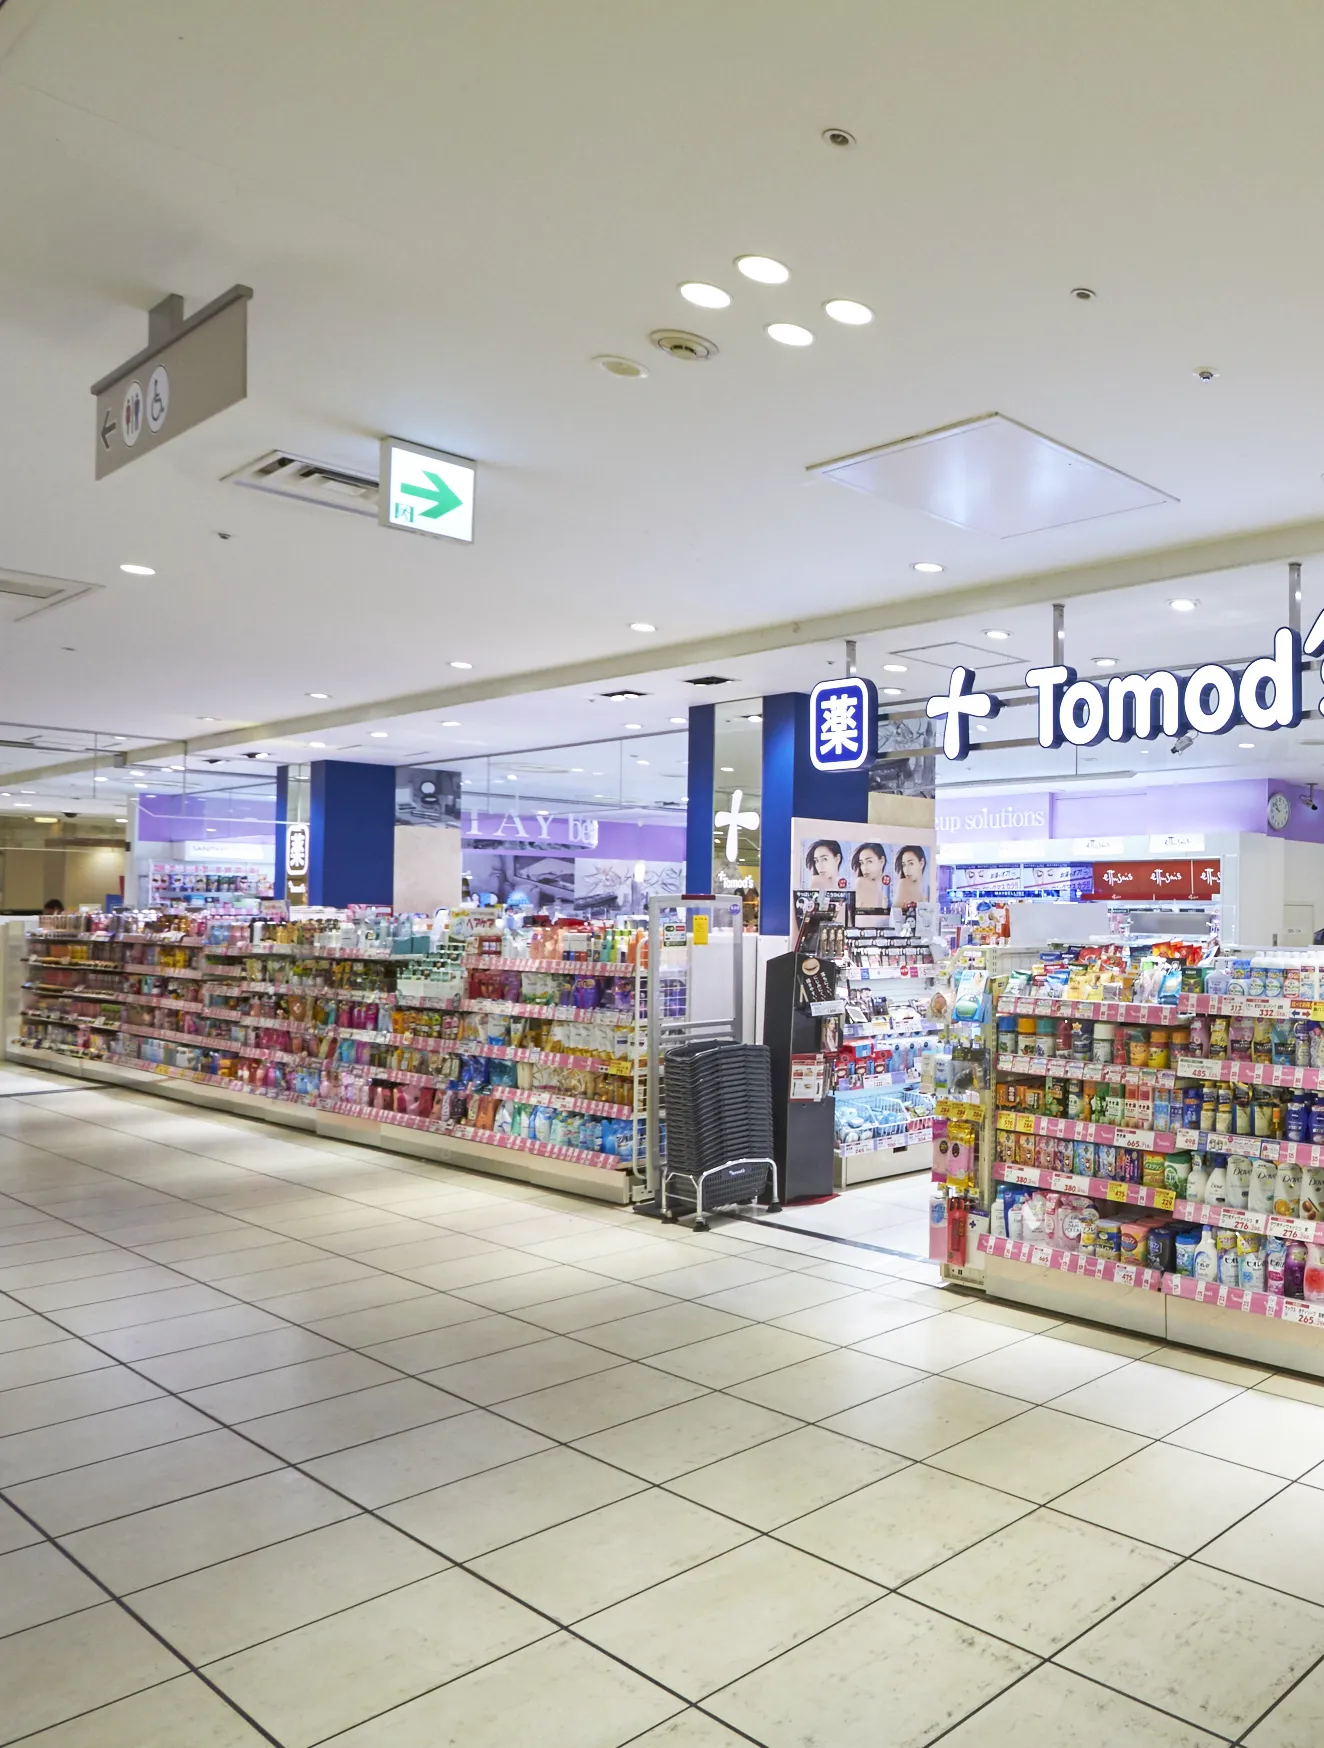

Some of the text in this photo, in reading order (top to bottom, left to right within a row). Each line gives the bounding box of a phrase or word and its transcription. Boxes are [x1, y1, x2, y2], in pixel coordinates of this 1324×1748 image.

[820, 694, 859, 755] 薬
[965, 806, 1046, 831] solutions
[1259, 1008, 1274, 1017] 332
[1192, 1070, 1206, 1078] 485
[1126, 1140, 1140, 1148] 665
[1016, 1176, 1028, 1184] 380
[1064, 1184, 1076, 1192] 380
[1234, 1220, 1249, 1230] 276
[1282, 1229, 1298, 1238] 276
[1298, 1314, 1314, 1325] 265
